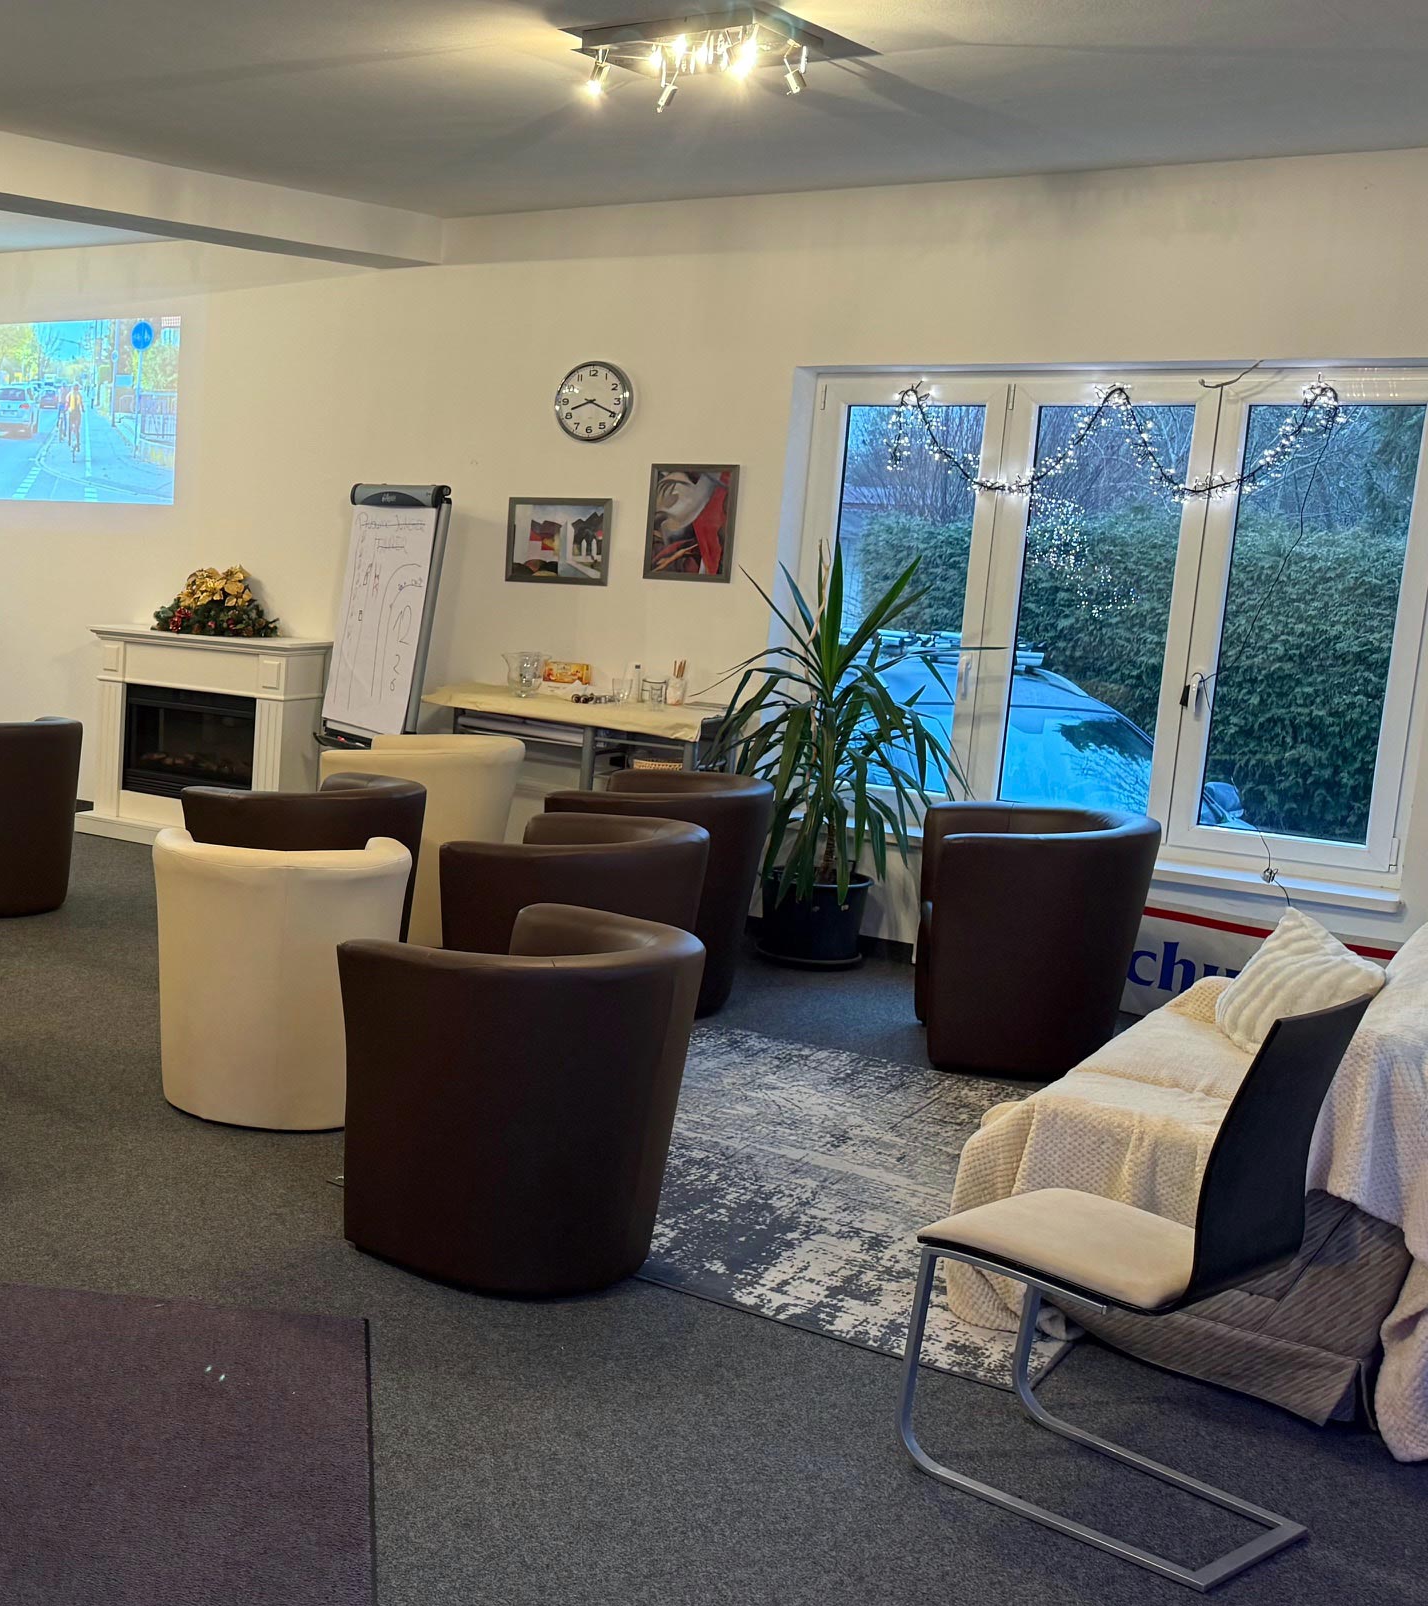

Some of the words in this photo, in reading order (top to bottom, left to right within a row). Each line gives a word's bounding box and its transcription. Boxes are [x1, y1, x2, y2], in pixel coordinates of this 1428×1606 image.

[589, 369, 599, 377] 12
[577, 373, 583, 382] 11
[611, 383, 619, 391] 2
[562, 398, 570, 406] 9
[613, 397, 621, 406] 3
[564, 412, 573, 420] 8
[609, 411, 617, 419] 4
[573, 422, 580, 431] 7
[585, 426, 593, 434] 6
[598, 422, 606, 430] 5
